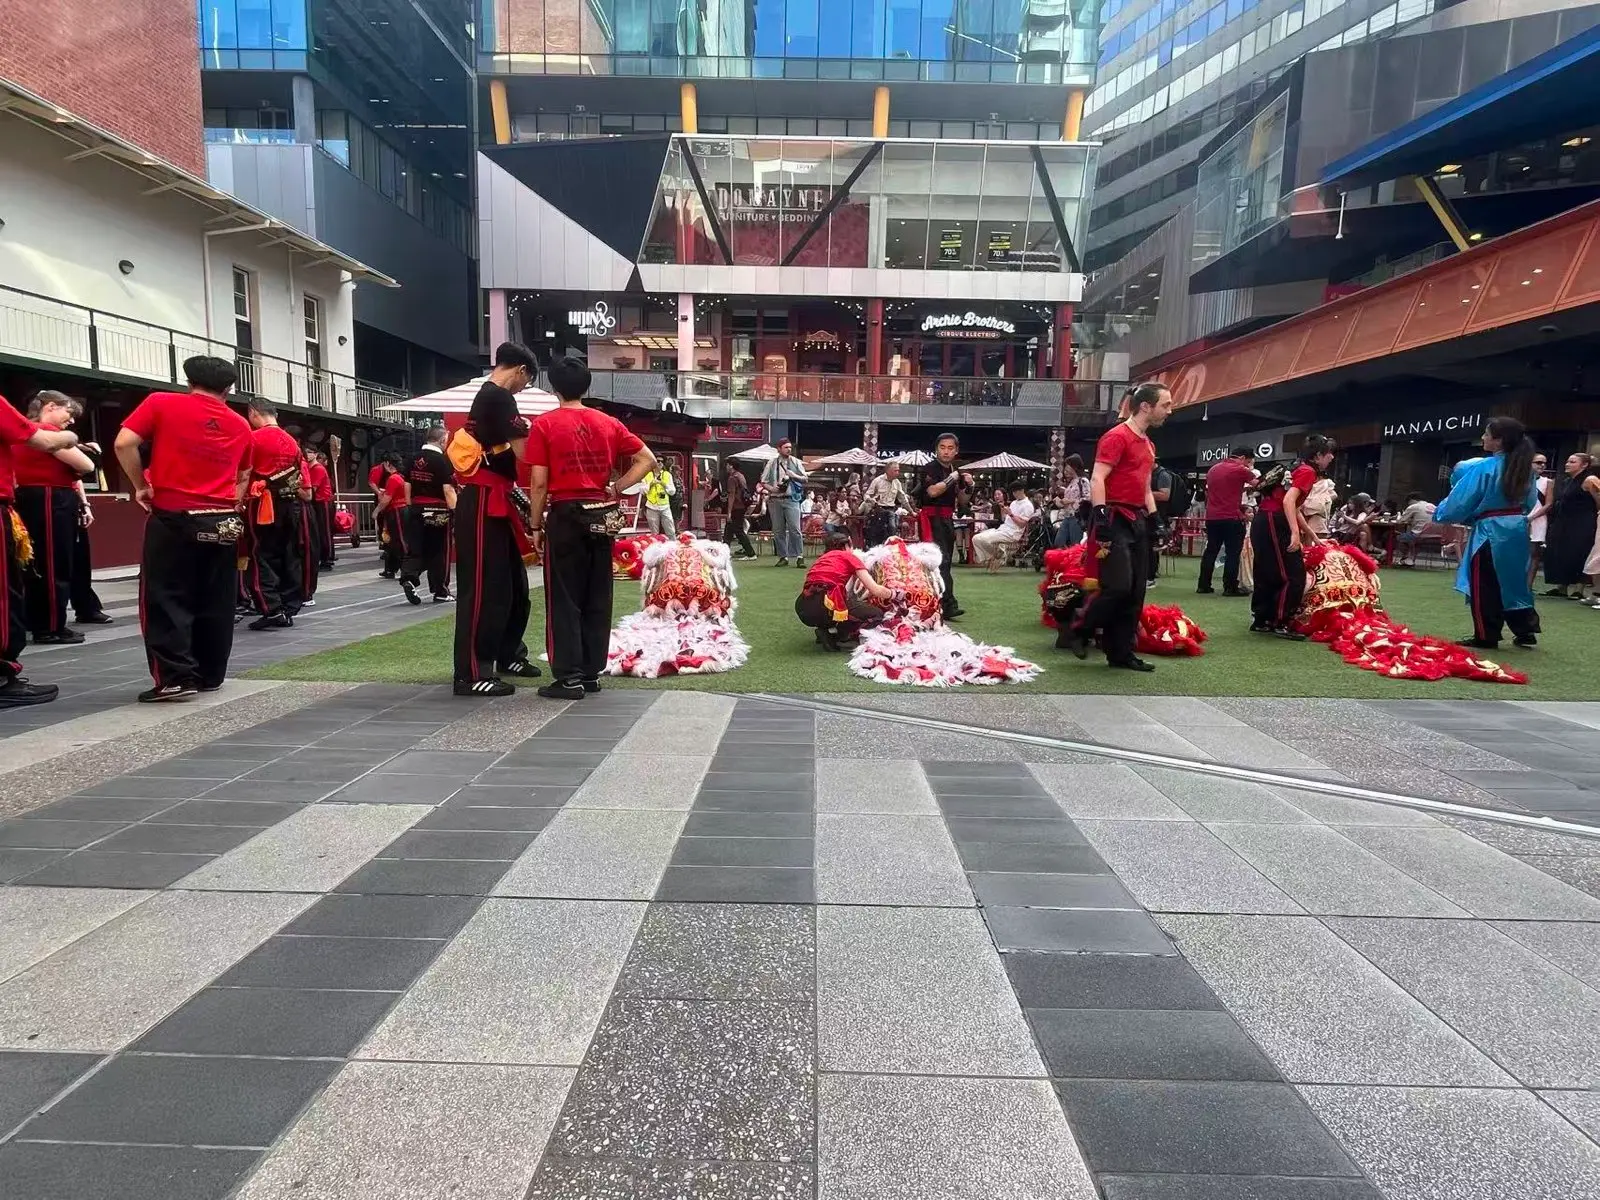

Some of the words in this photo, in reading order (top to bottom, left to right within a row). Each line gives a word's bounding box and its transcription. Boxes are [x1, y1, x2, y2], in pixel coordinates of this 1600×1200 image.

[717, 187, 824, 212] DOMAYNE
[719, 212, 770, 222] FURNITURE
[568, 301, 616, 336] HIJINX
[921, 314, 962, 331] Archie
[962, 311, 1015, 333] Brothers
[1384, 414, 1480, 436] HANAICHI
